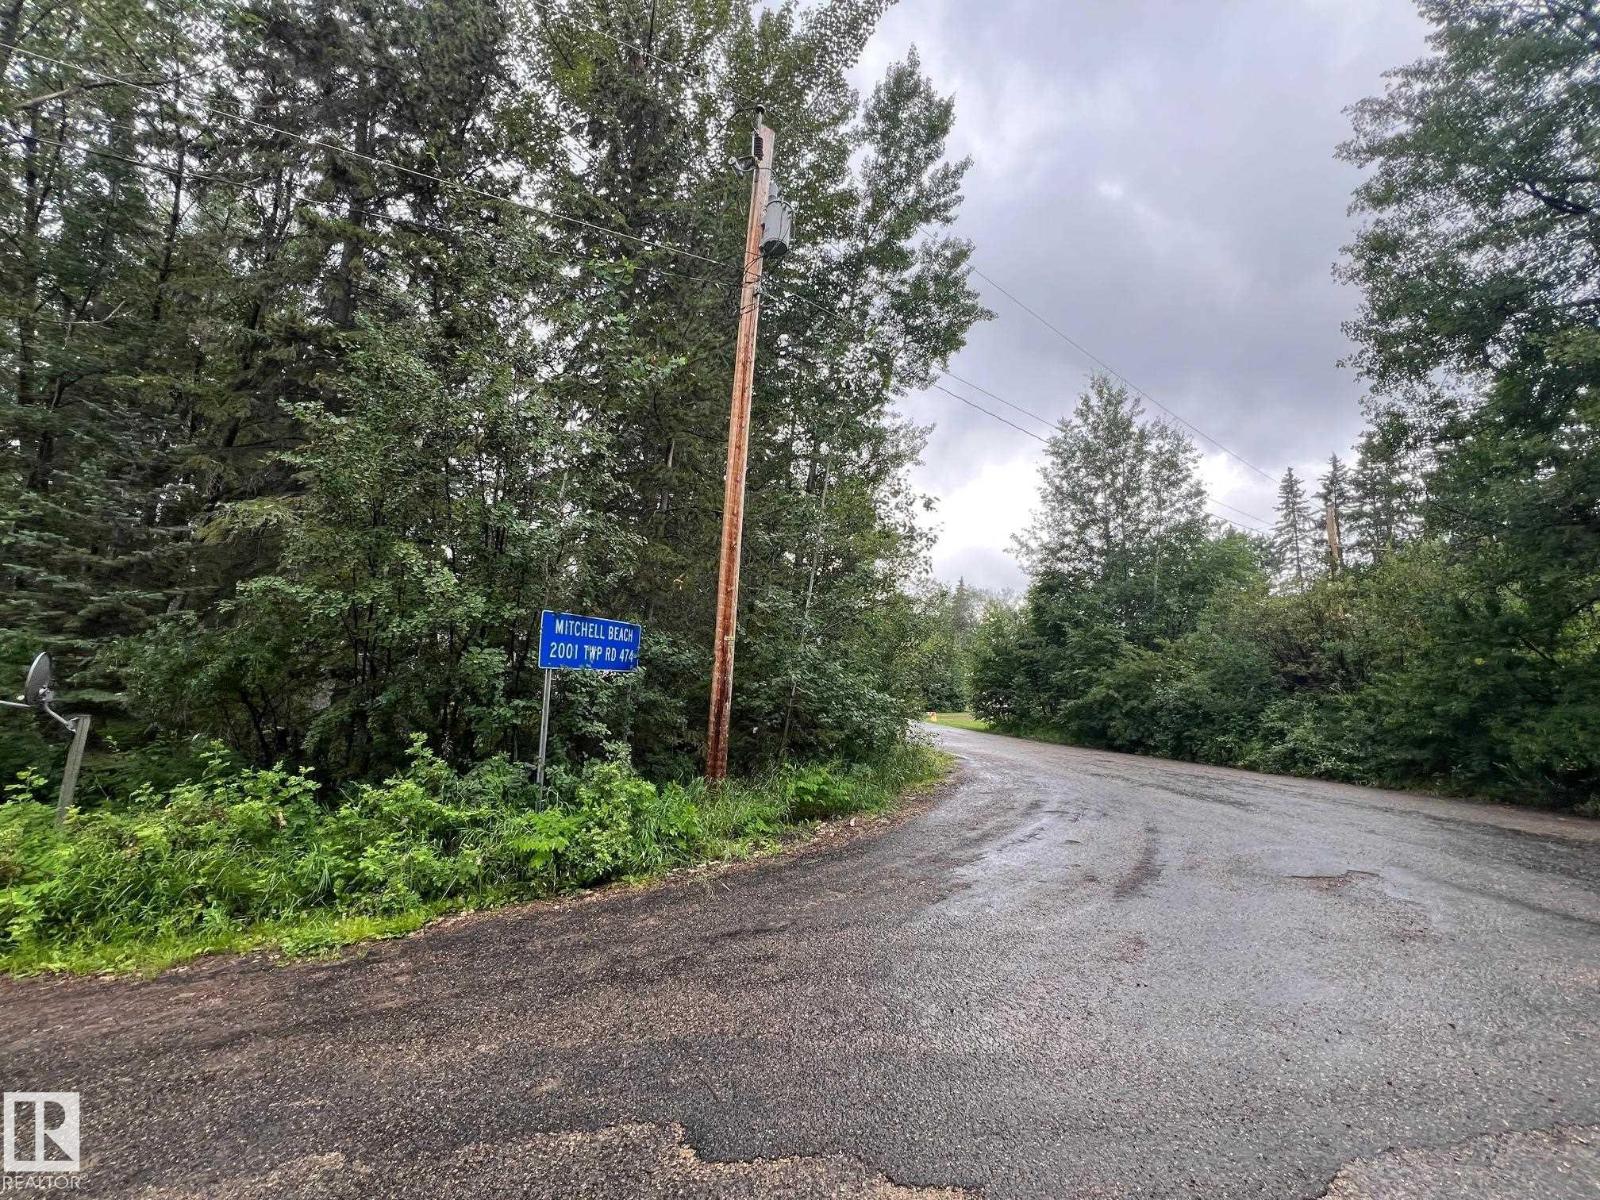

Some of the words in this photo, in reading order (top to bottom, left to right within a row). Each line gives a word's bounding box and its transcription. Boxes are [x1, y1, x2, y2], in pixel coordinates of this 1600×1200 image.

[555, 619, 605, 639] MITCHELL
[608, 626, 633, 643] BEACH
[549, 642, 578, 659] 2001
[584, 645, 602, 661] TWP
[605, 647, 617, 662] RD
